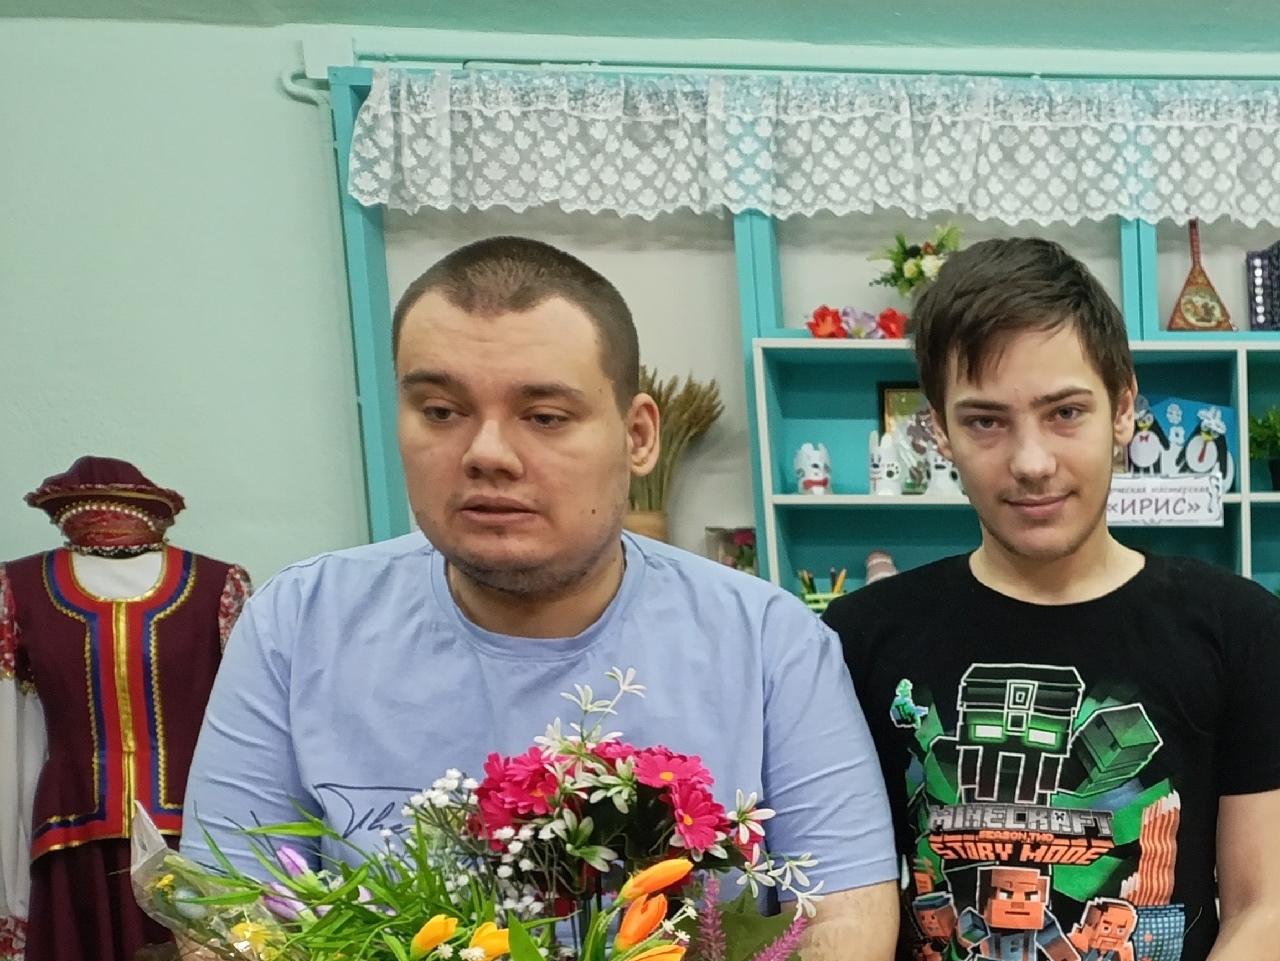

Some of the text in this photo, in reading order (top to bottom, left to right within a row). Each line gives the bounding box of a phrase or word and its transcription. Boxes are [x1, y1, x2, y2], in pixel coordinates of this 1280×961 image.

[1107, 497, 1201, 515] «ИРИС»
[929, 804, 1114, 837] MINECRAFT
[978, 830, 1055, 844] SEASON TWO
[928, 836, 1114, 865] STORY MODE
